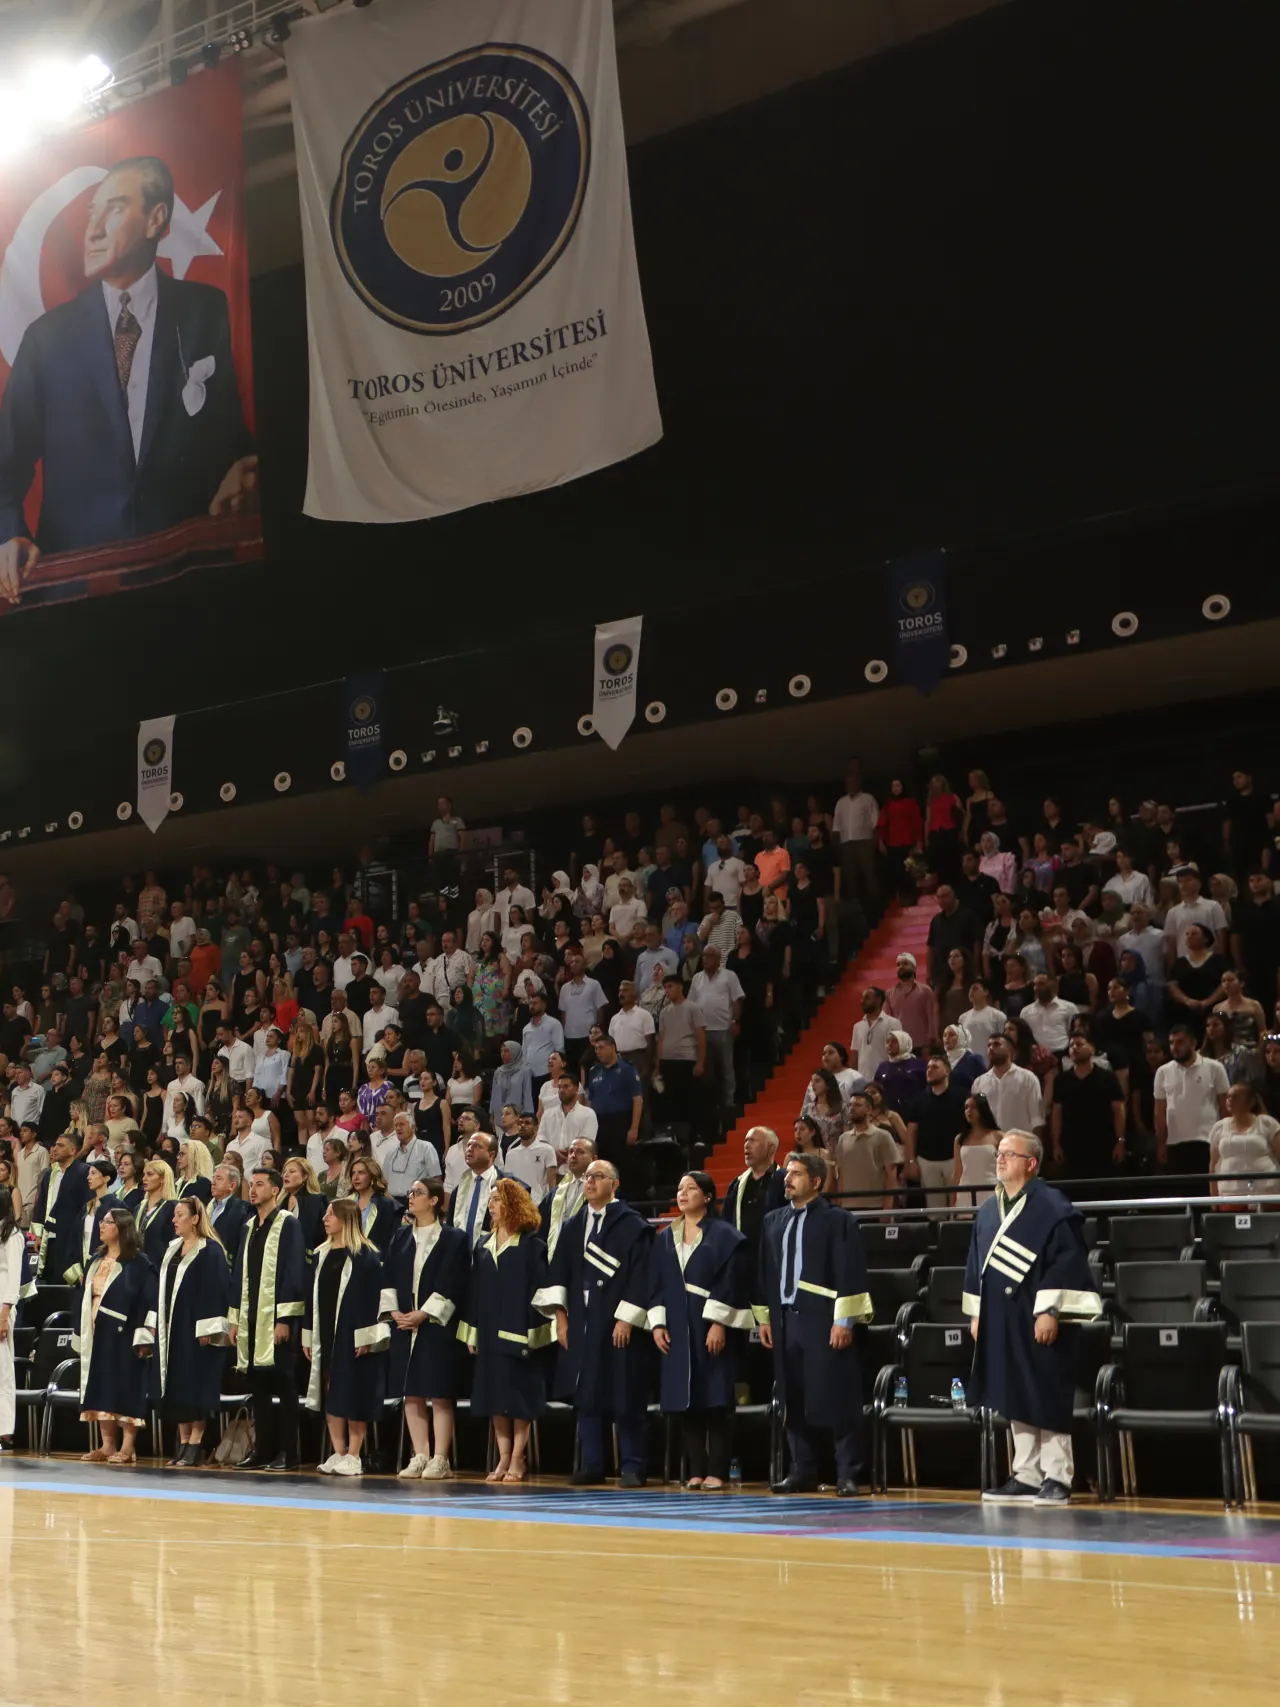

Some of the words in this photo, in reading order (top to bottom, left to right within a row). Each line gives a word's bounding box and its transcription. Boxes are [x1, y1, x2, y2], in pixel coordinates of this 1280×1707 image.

[353, 116, 404, 212] TOROS
[404, 75, 564, 142] ÜNİVERSİTESİ
[438, 272, 497, 313] 2009
[348, 371, 425, 402] TOROS
[431, 308, 609, 390] ÜNİVERSİTESİ
[898, 612, 942, 631] TOROS
[599, 673, 633, 689] TOROS
[348, 724, 380, 739] TOROS
[141, 766, 168, 779] TOROS
[948, 1333, 959, 1341] 10
